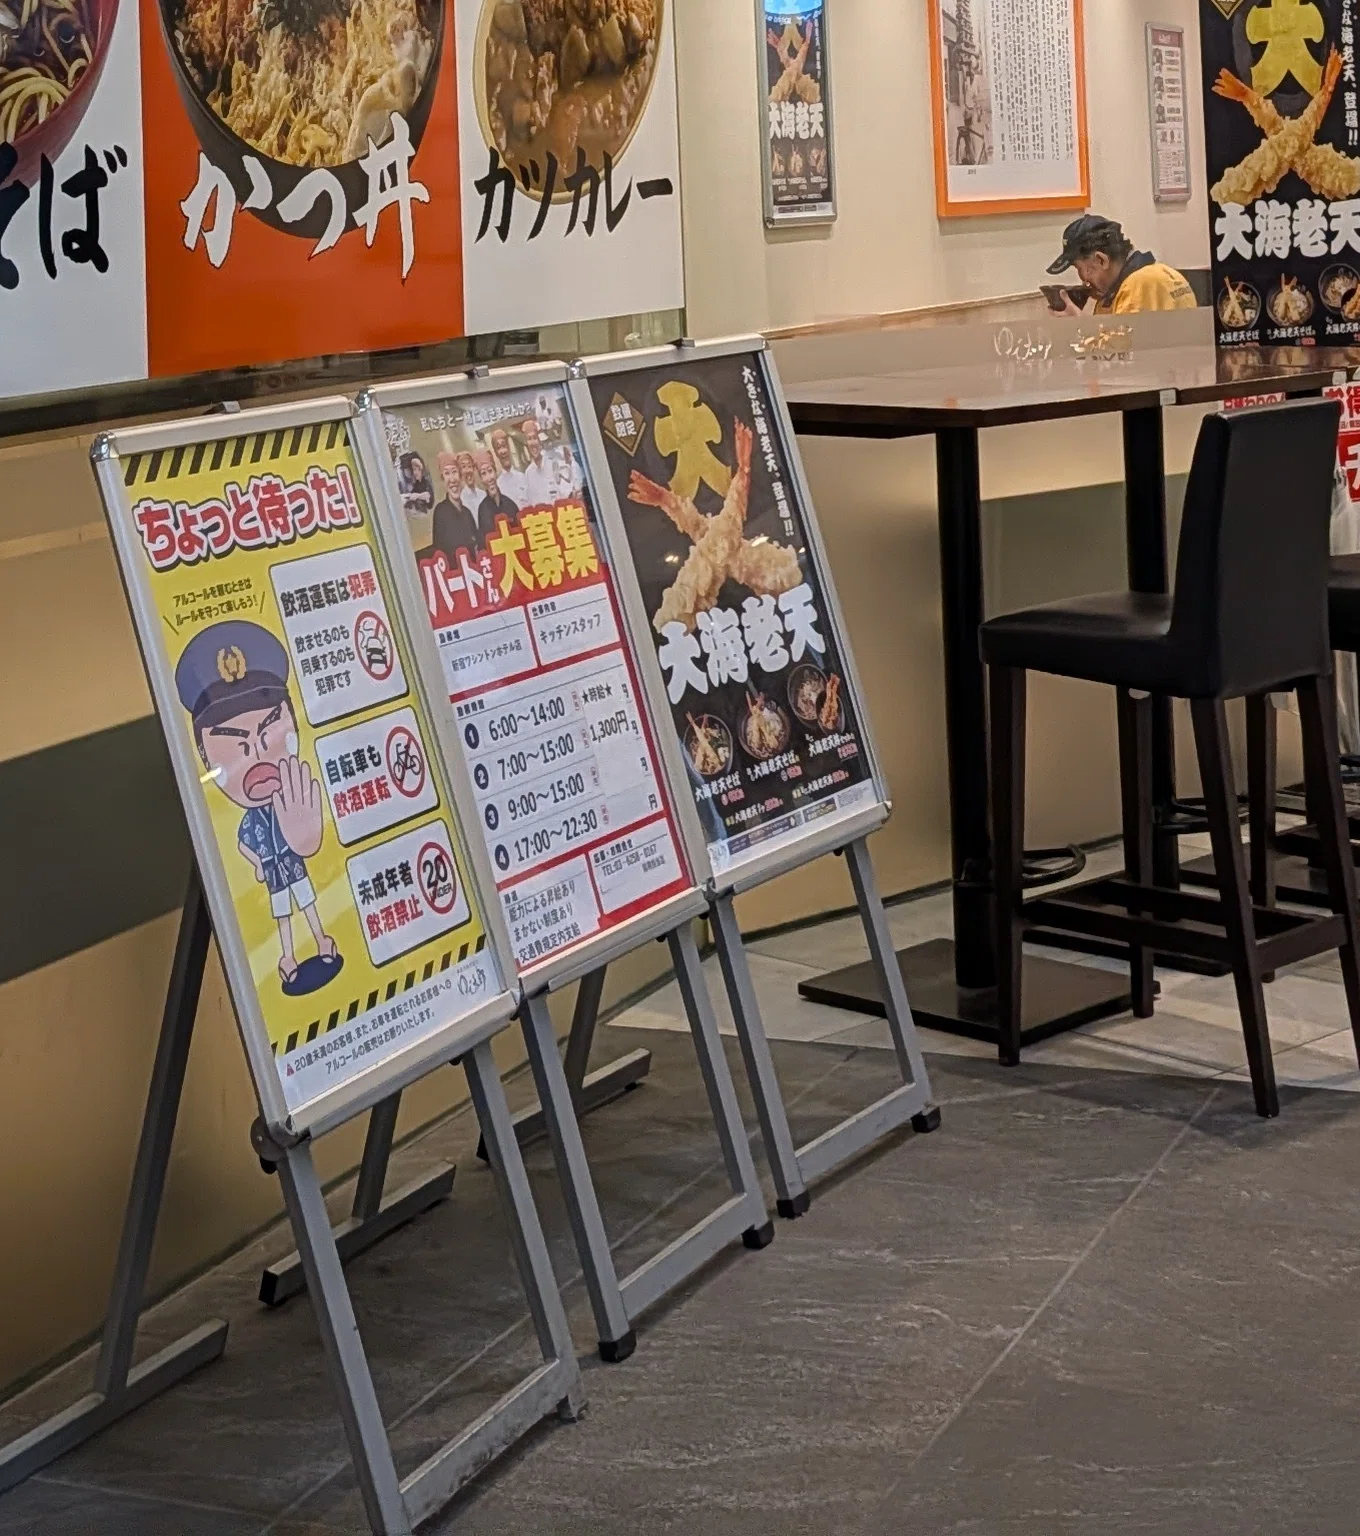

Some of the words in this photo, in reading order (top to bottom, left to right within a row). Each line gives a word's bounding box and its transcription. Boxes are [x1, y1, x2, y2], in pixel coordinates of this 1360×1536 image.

[180, 110, 432, 284] かつ丼
[474, 145, 674, 244] カツカレー
[136, 468, 360, 563] ちょっと待った!
[280, 570, 377, 618] 飲酒運転は犯罪
[294, 624, 350, 654] 飲ませるのも
[541, 614, 602, 644] キッチンスタッフ
[658, 583, 827, 705] 大海老天
[300, 646, 356, 677] 同乗するのも
[315, 670, 352, 696] 犯罪です
[590, 710, 629, 743] 1,300円
[325, 744, 382, 785] 自転車も
[332, 775, 392, 818] 飲酒運転
[358, 860, 414, 905] 未成年者
[423, 854, 448, 889] 20
[365, 894, 424, 940] 飲酒禁止
[508, 880, 576, 923] 能力による昇給あり
[513, 902, 573, 942] まかない制度あり
[519, 922, 581, 964] 交通費規定内支給
